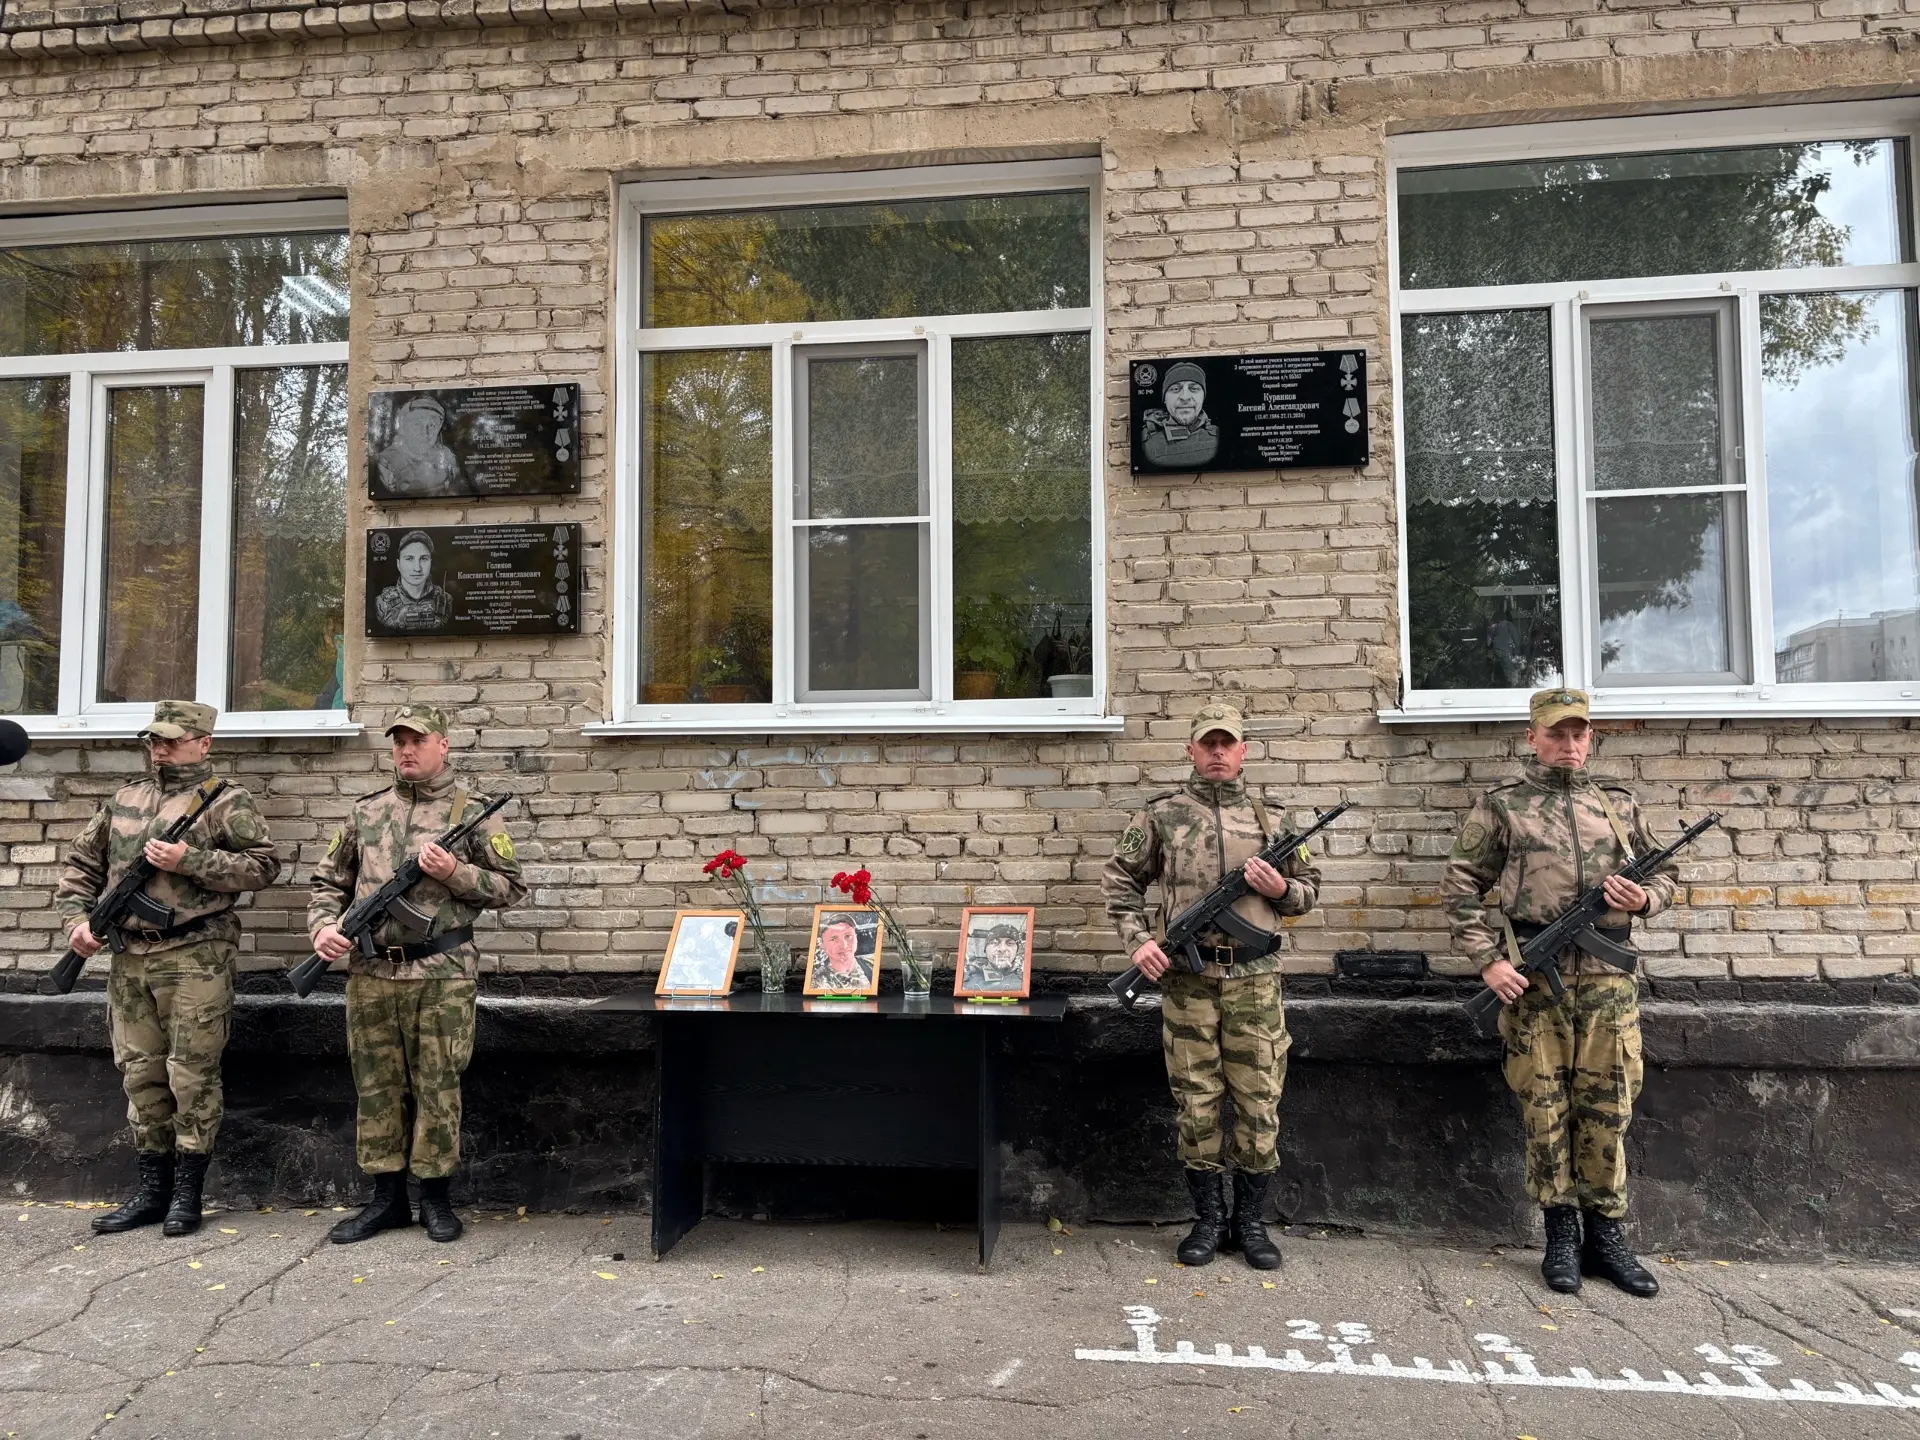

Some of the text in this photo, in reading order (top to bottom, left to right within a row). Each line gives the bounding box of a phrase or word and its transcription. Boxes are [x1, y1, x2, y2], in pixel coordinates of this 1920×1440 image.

[1238, 403, 1320, 412] Евгений Александрович
[1121, 1304, 1162, 1324] 3
[1285, 1319, 1375, 1344] 2.5
[1474, 1333, 1523, 1353] 2
